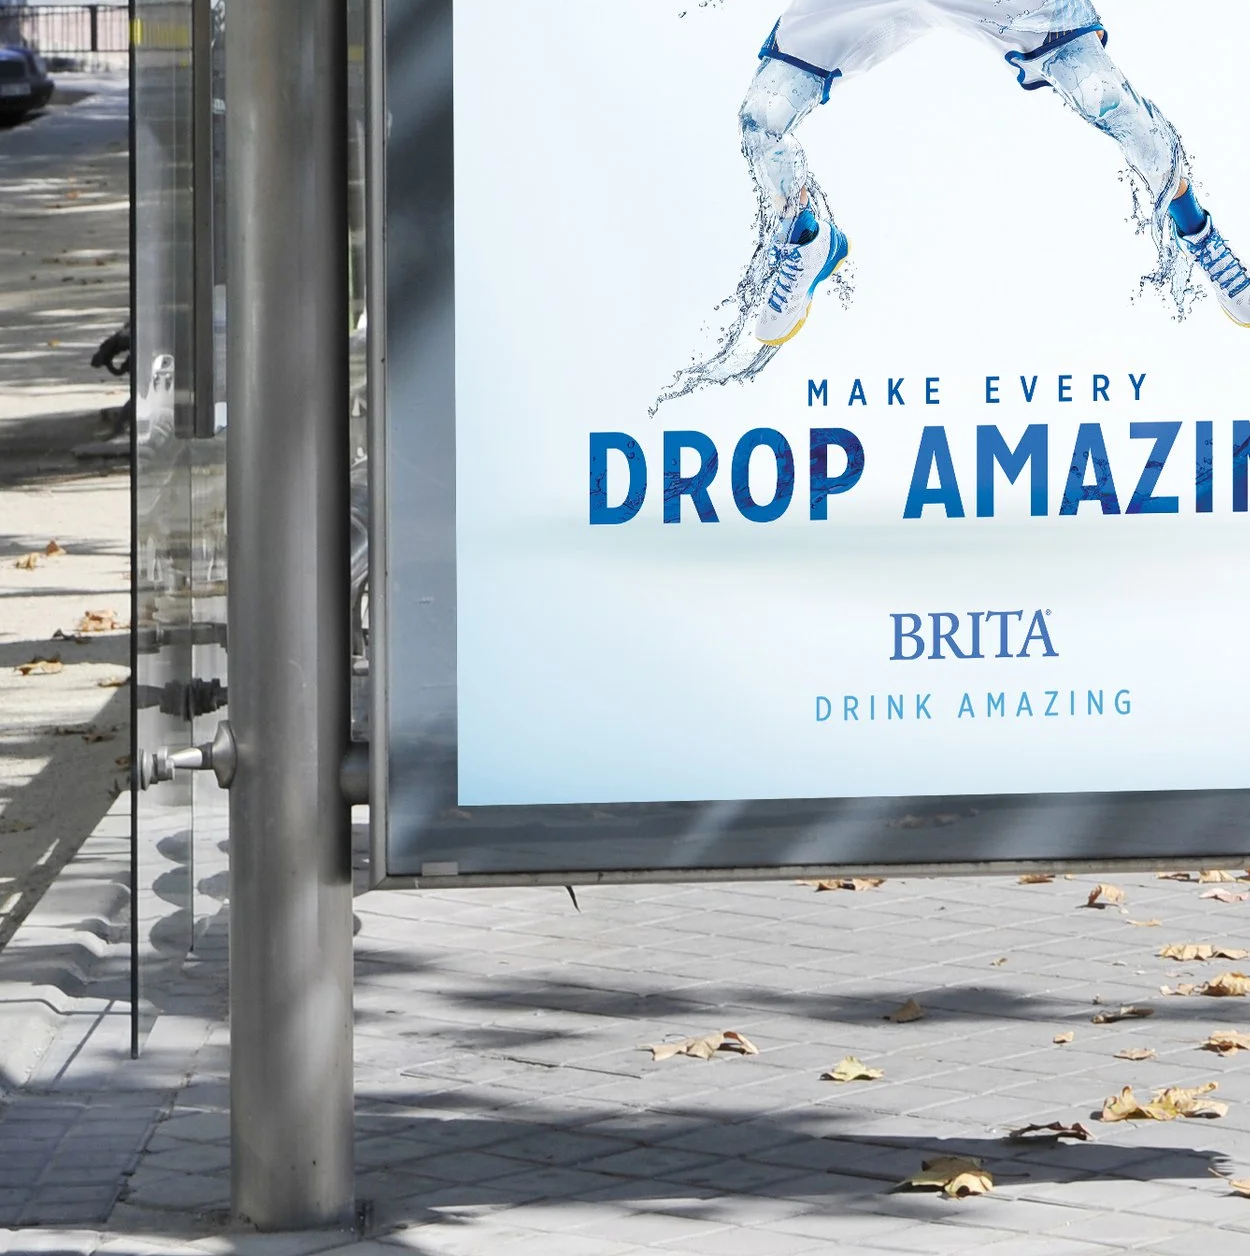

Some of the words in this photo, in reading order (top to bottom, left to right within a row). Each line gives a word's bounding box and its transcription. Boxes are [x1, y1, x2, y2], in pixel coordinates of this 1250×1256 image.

[807, 377, 940, 408] MAKE
[985, 372, 1148, 404] EVERY
[589, 427, 865, 525] DROP
[815, 693, 933, 722] DRINK
[957, 688, 1134, 718] AMAZING
